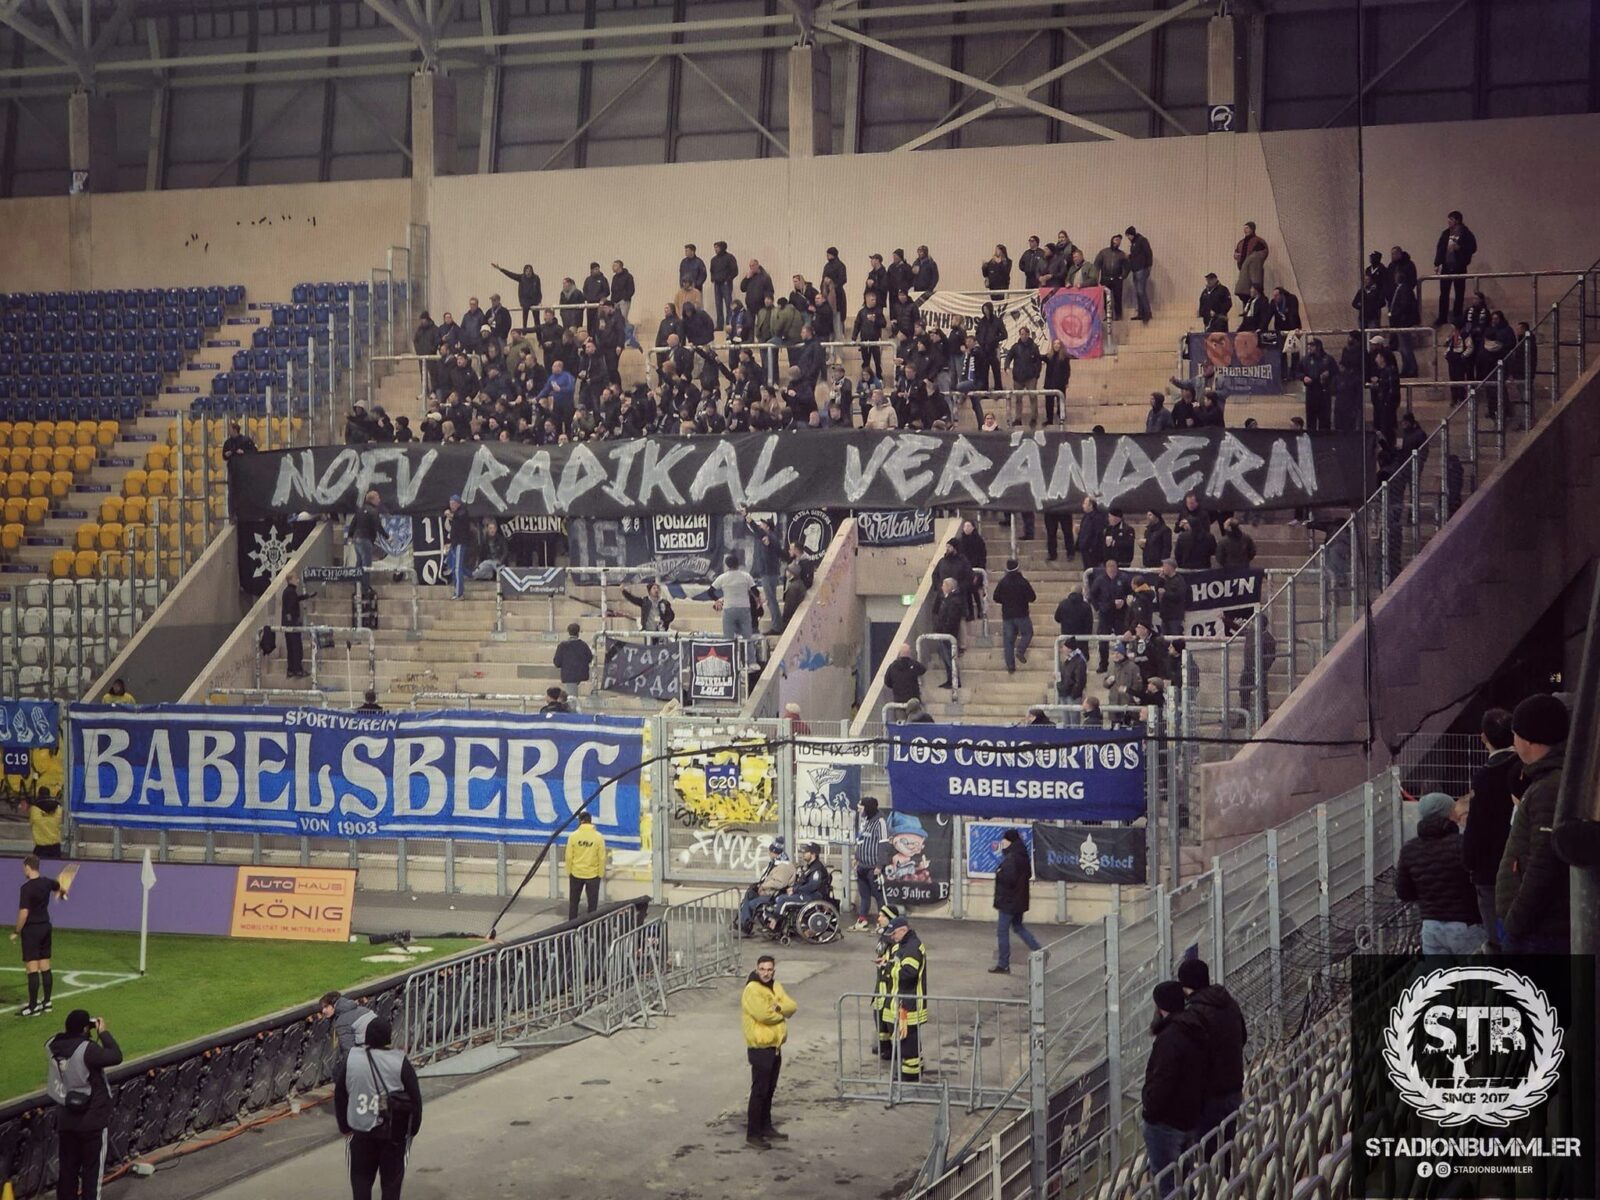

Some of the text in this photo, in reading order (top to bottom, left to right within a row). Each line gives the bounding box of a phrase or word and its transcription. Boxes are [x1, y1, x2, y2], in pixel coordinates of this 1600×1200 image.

[271, 430, 1317, 514] NOFV RADIKAL VERÄNDERN
[655, 514, 707, 530] POLIZIA
[659, 532, 705, 549] MERDA
[1191, 576, 1256, 602] HOL'N
[285, 710, 398, 731] SPORTVEREIN
[5, 753, 28, 765] C19
[893, 735, 948, 764] LOS
[82, 728, 620, 826] BABELSBERG
[708, 776, 736, 789] C20
[949, 776, 1085, 800] BABELSBERG
[300, 818, 378, 835] VON 1903
[250, 879, 294, 889] AUTO
[901, 886, 931, 900] Jahre
[242, 899, 344, 921] KÖNIG
[356, 1094, 379, 1115] 34
